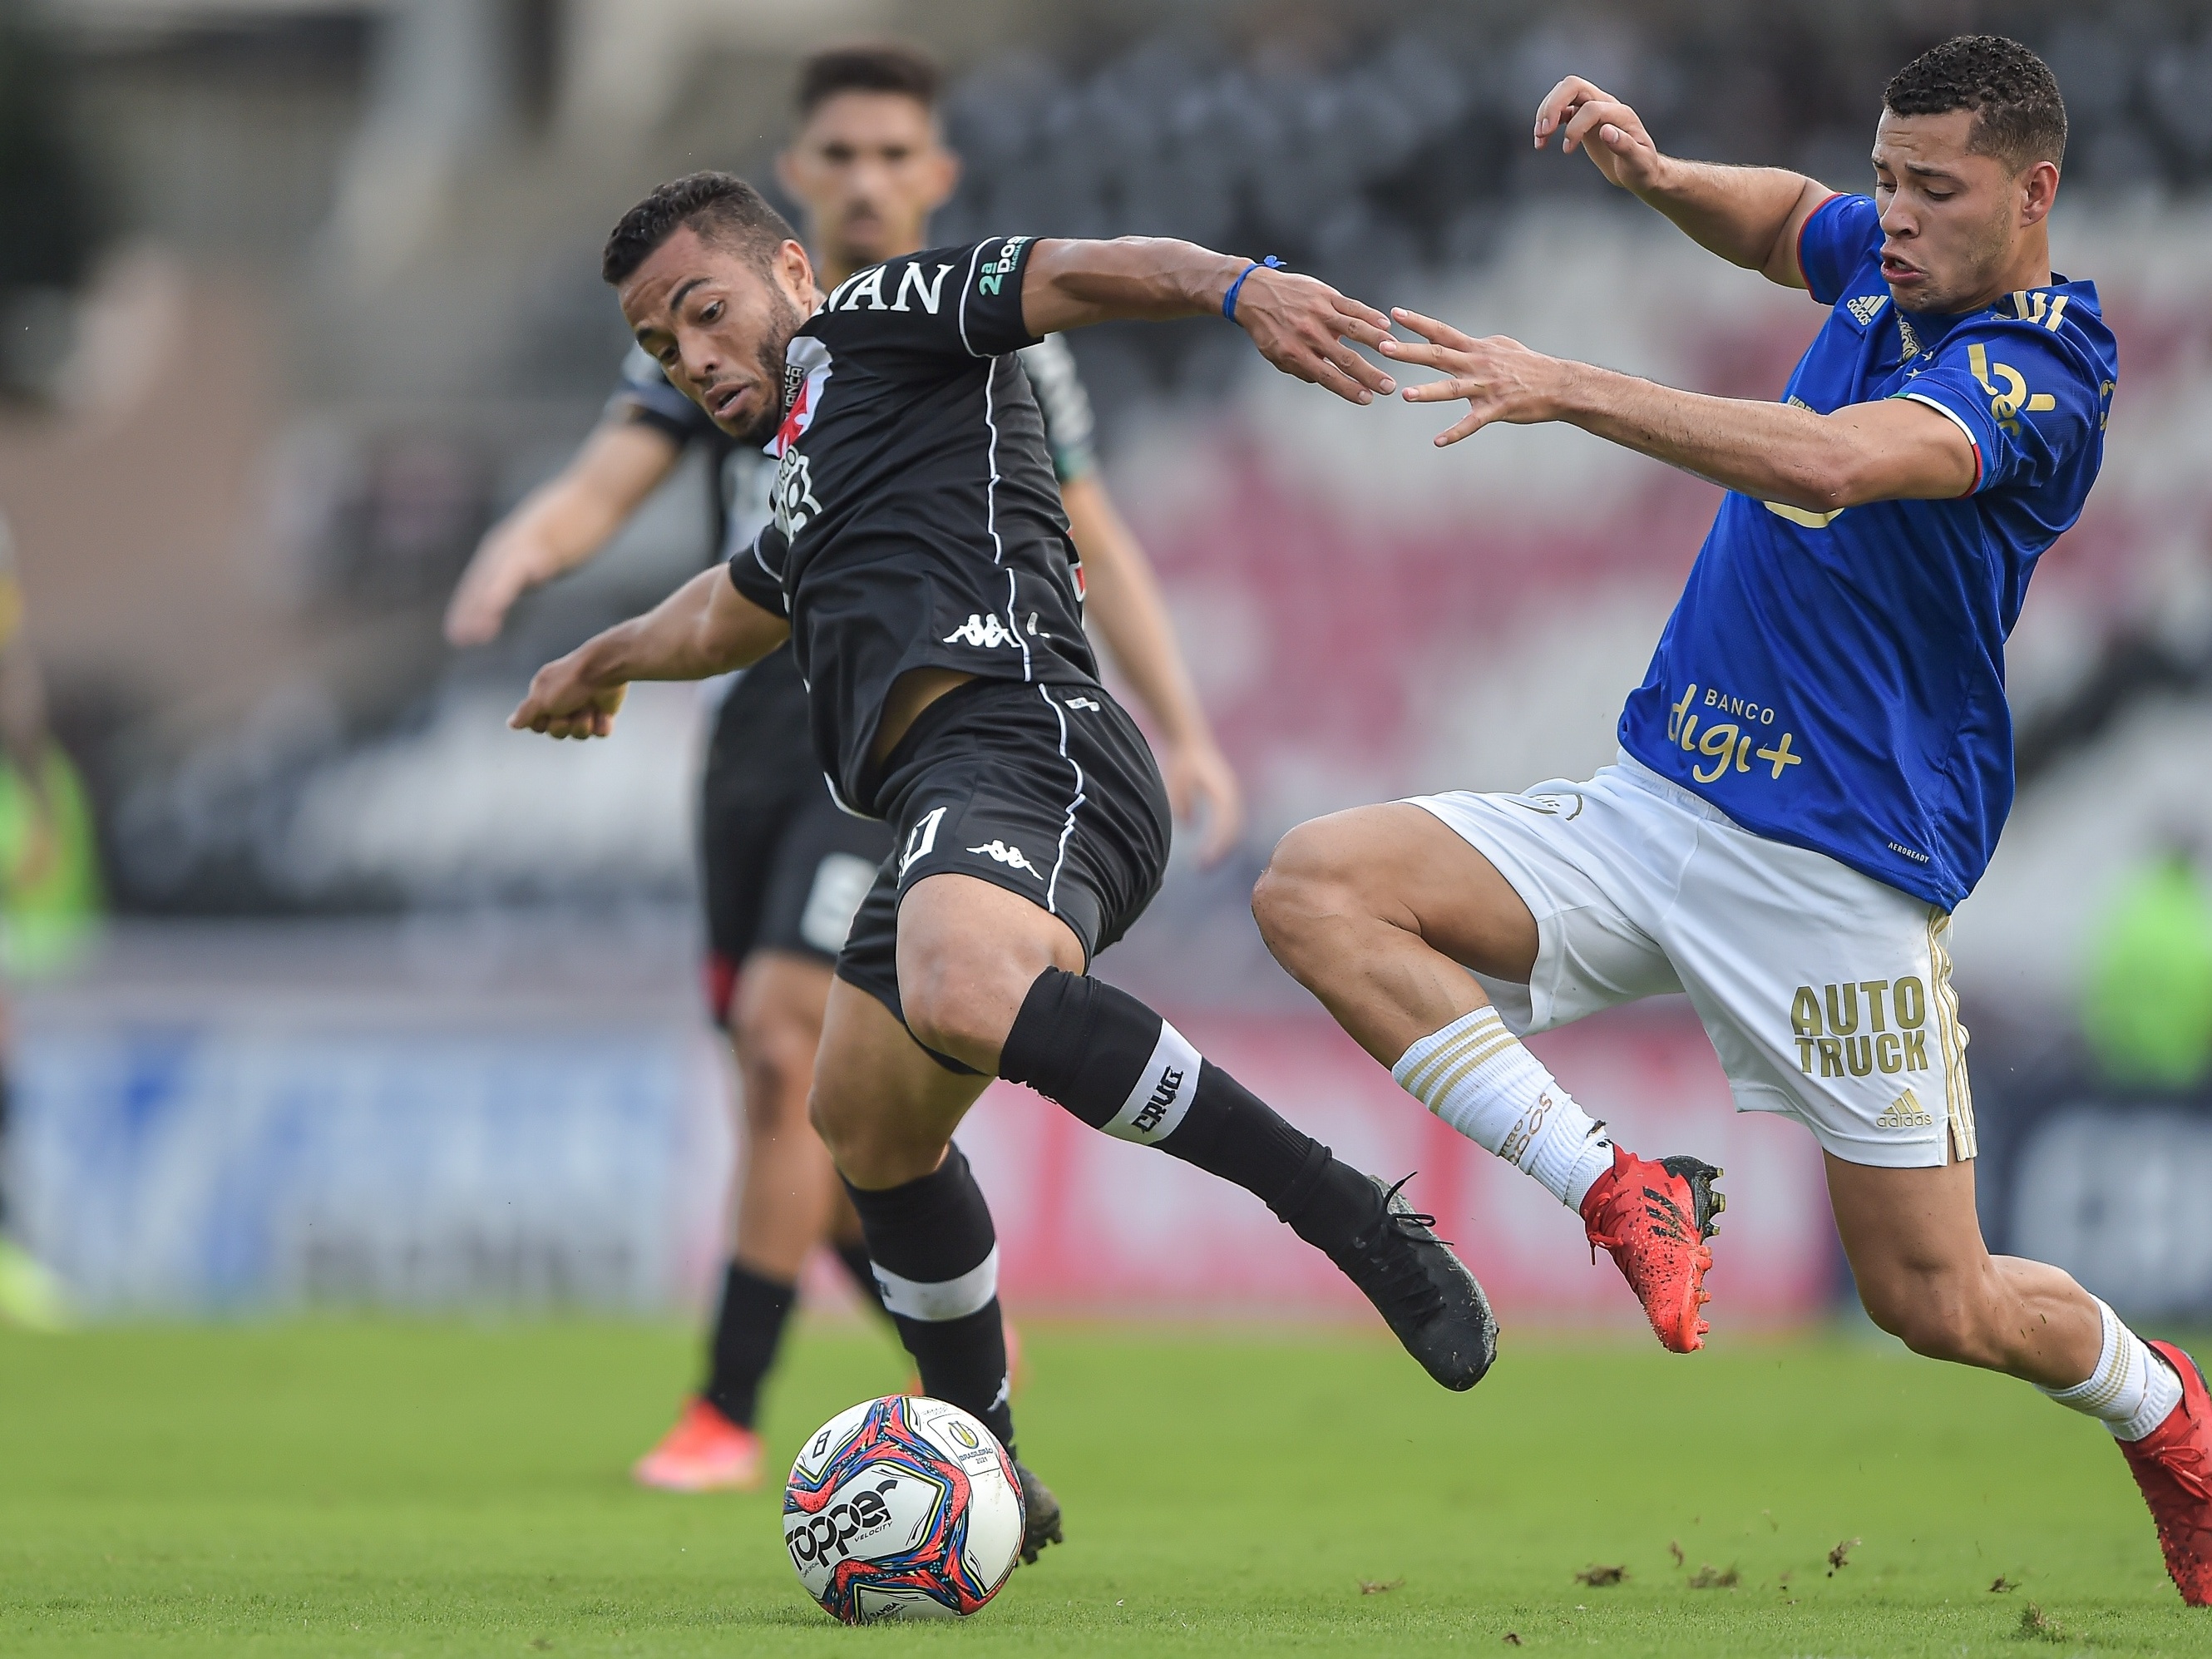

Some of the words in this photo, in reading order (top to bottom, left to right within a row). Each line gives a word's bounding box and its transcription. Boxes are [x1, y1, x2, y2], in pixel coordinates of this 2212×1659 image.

[1846, 299, 1872, 326] adidas
[1703, 689, 1775, 726] BANCO
[1888, 842, 1930, 864] AEROREADY
[1790, 975, 1927, 1037] AUTO
[1794, 1030, 1929, 1079] TRUCK
[1876, 1113, 1933, 1128] adidas
[975, 1456, 988, 1464] 2021
[854, 1521, 893, 1543] VELOCITY
